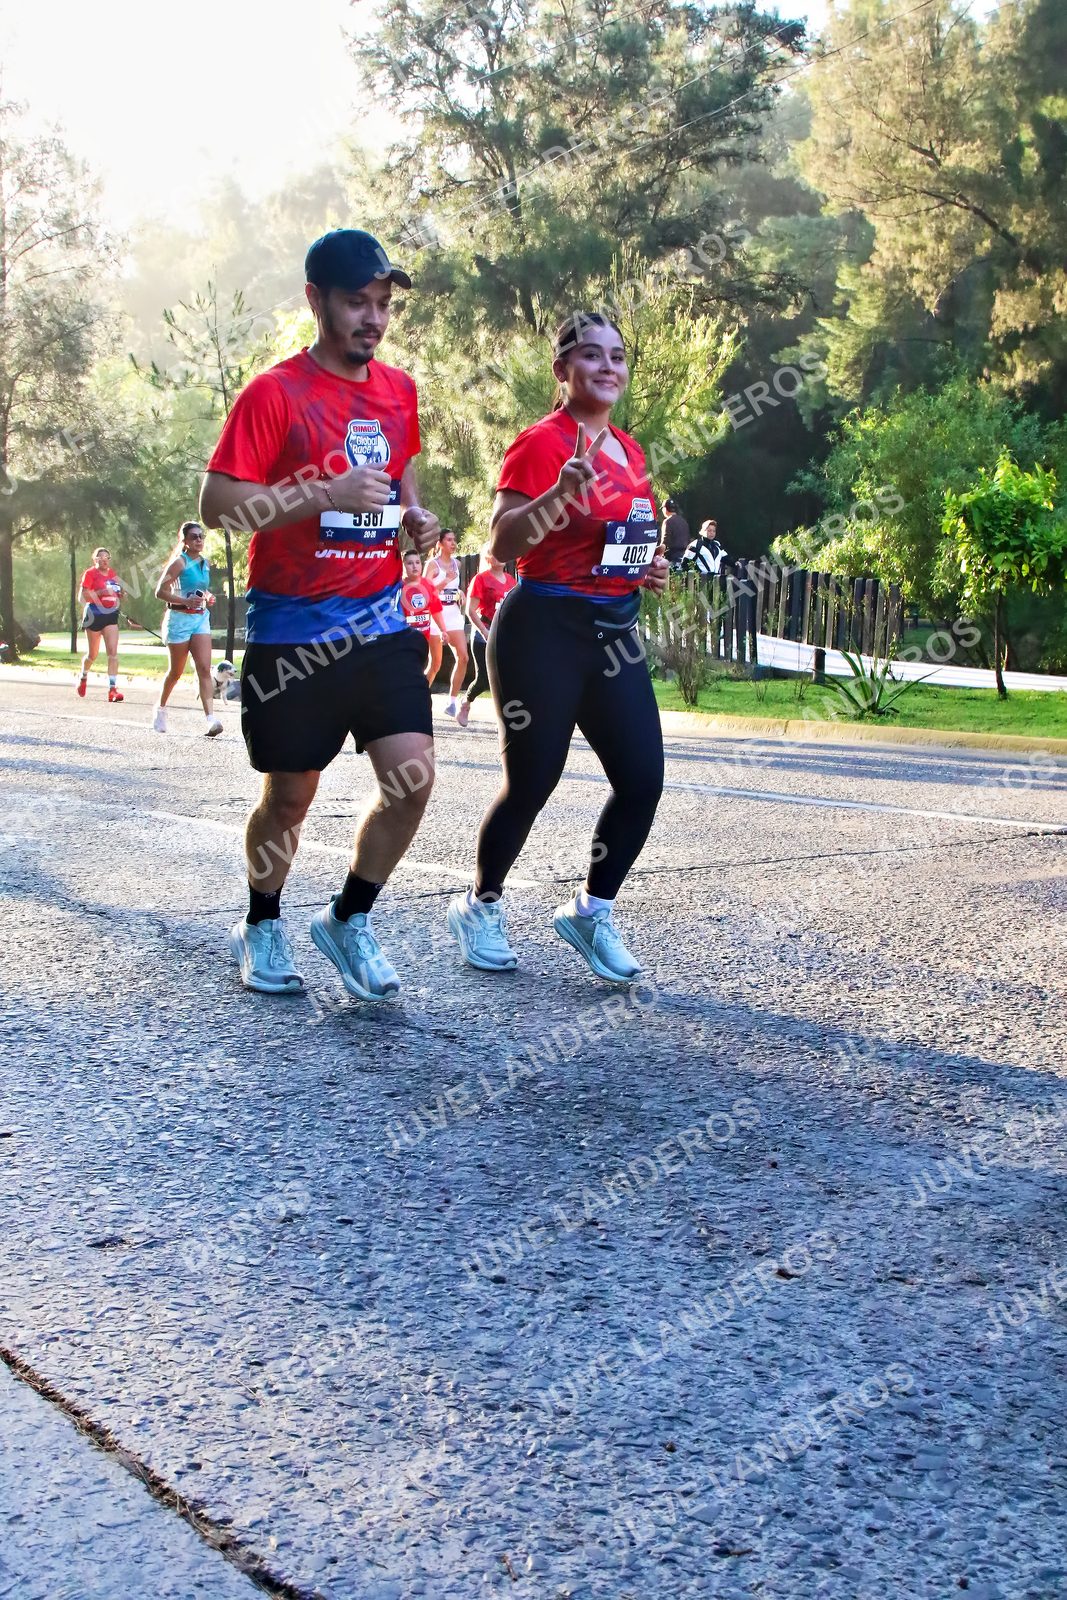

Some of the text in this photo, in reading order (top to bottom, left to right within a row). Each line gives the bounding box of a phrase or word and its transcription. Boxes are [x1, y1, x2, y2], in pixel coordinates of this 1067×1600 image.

[356, 436, 378, 446] Global
[352, 445, 372, 454] Race
[623, 545, 648, 564] 4022
